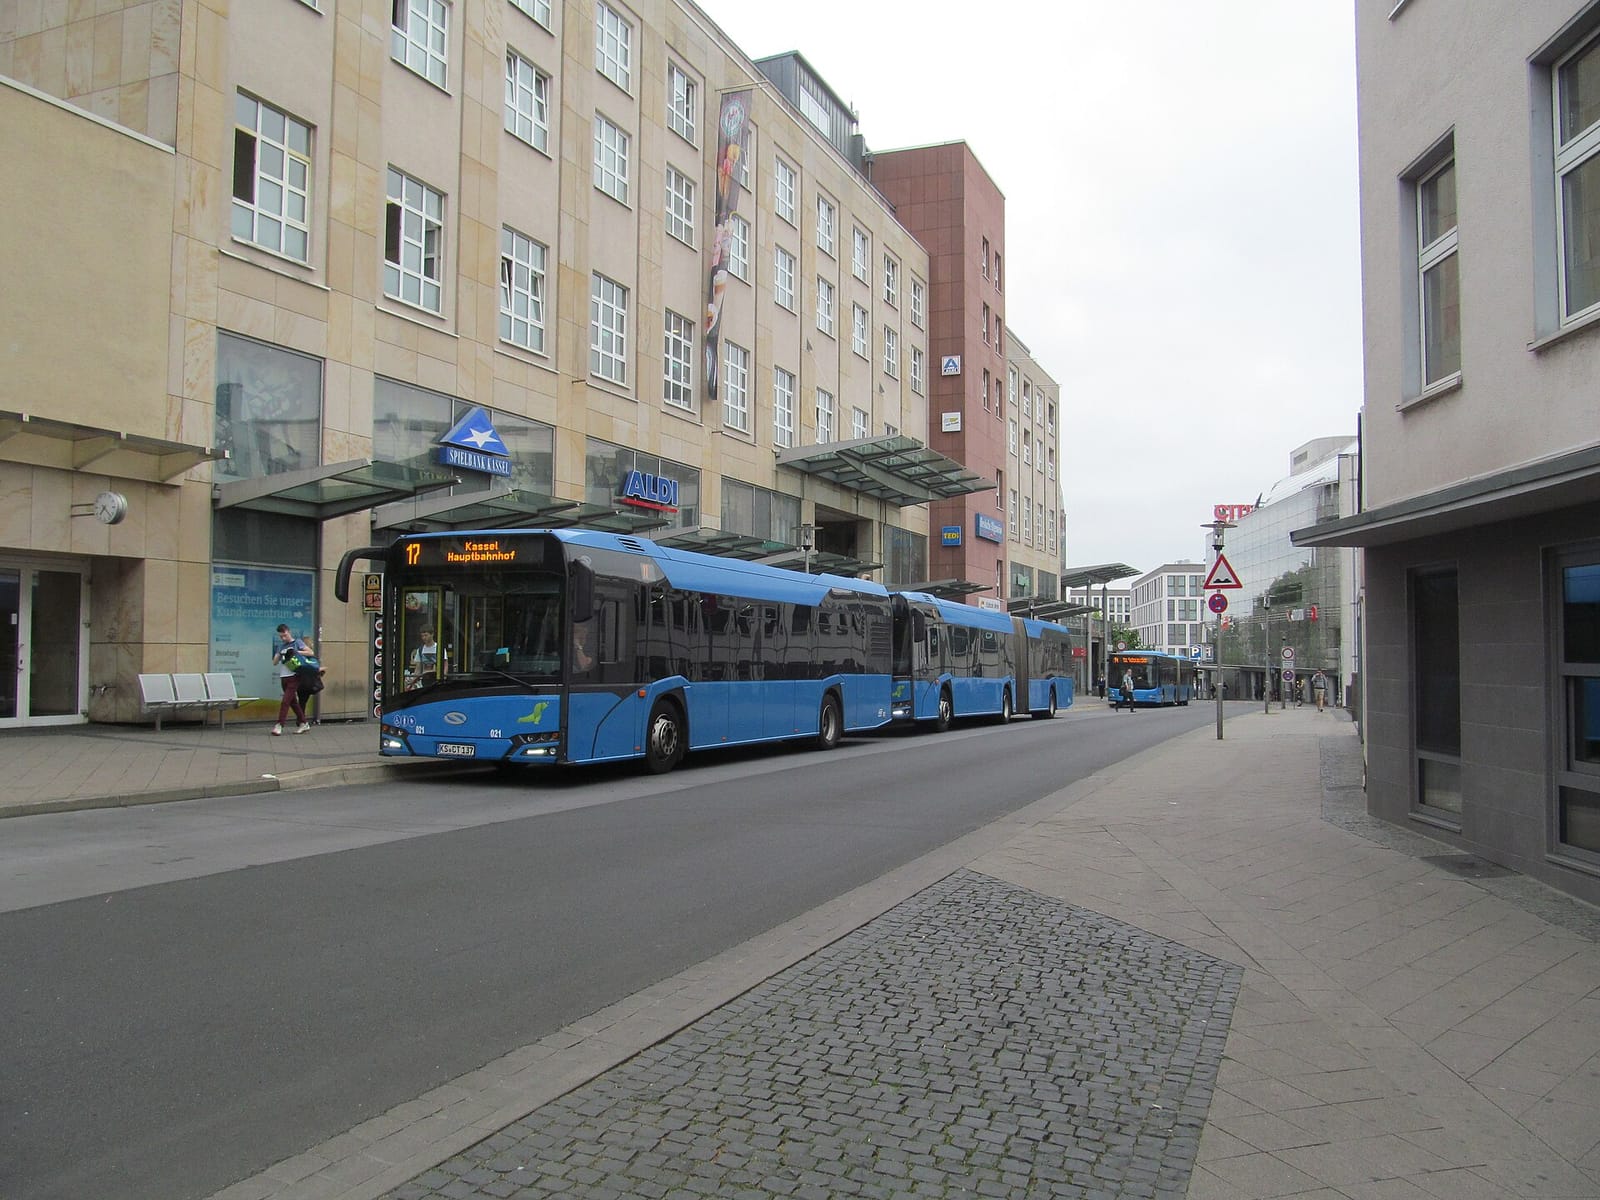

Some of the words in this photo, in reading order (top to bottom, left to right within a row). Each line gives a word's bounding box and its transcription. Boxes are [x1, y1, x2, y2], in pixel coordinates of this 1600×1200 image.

[449, 449, 486, 470] SPIELBANK
[487, 457, 509, 474] KASSEL
[625, 470, 679, 507] ALDI
[465, 541, 499, 551] Kassel
[406, 543, 421, 565] 17
[447, 551, 516, 563] Hauptbahnhof
[217, 592, 263, 605] Besuchen
[264, 595, 278, 606] Sie
[279, 597, 304, 607] unser
[217, 606, 293, 619] Kundenzentrum
[1191, 647, 1200, 657] P
[415, 726, 425, 734] 021
[490, 729, 502, 738] 021
